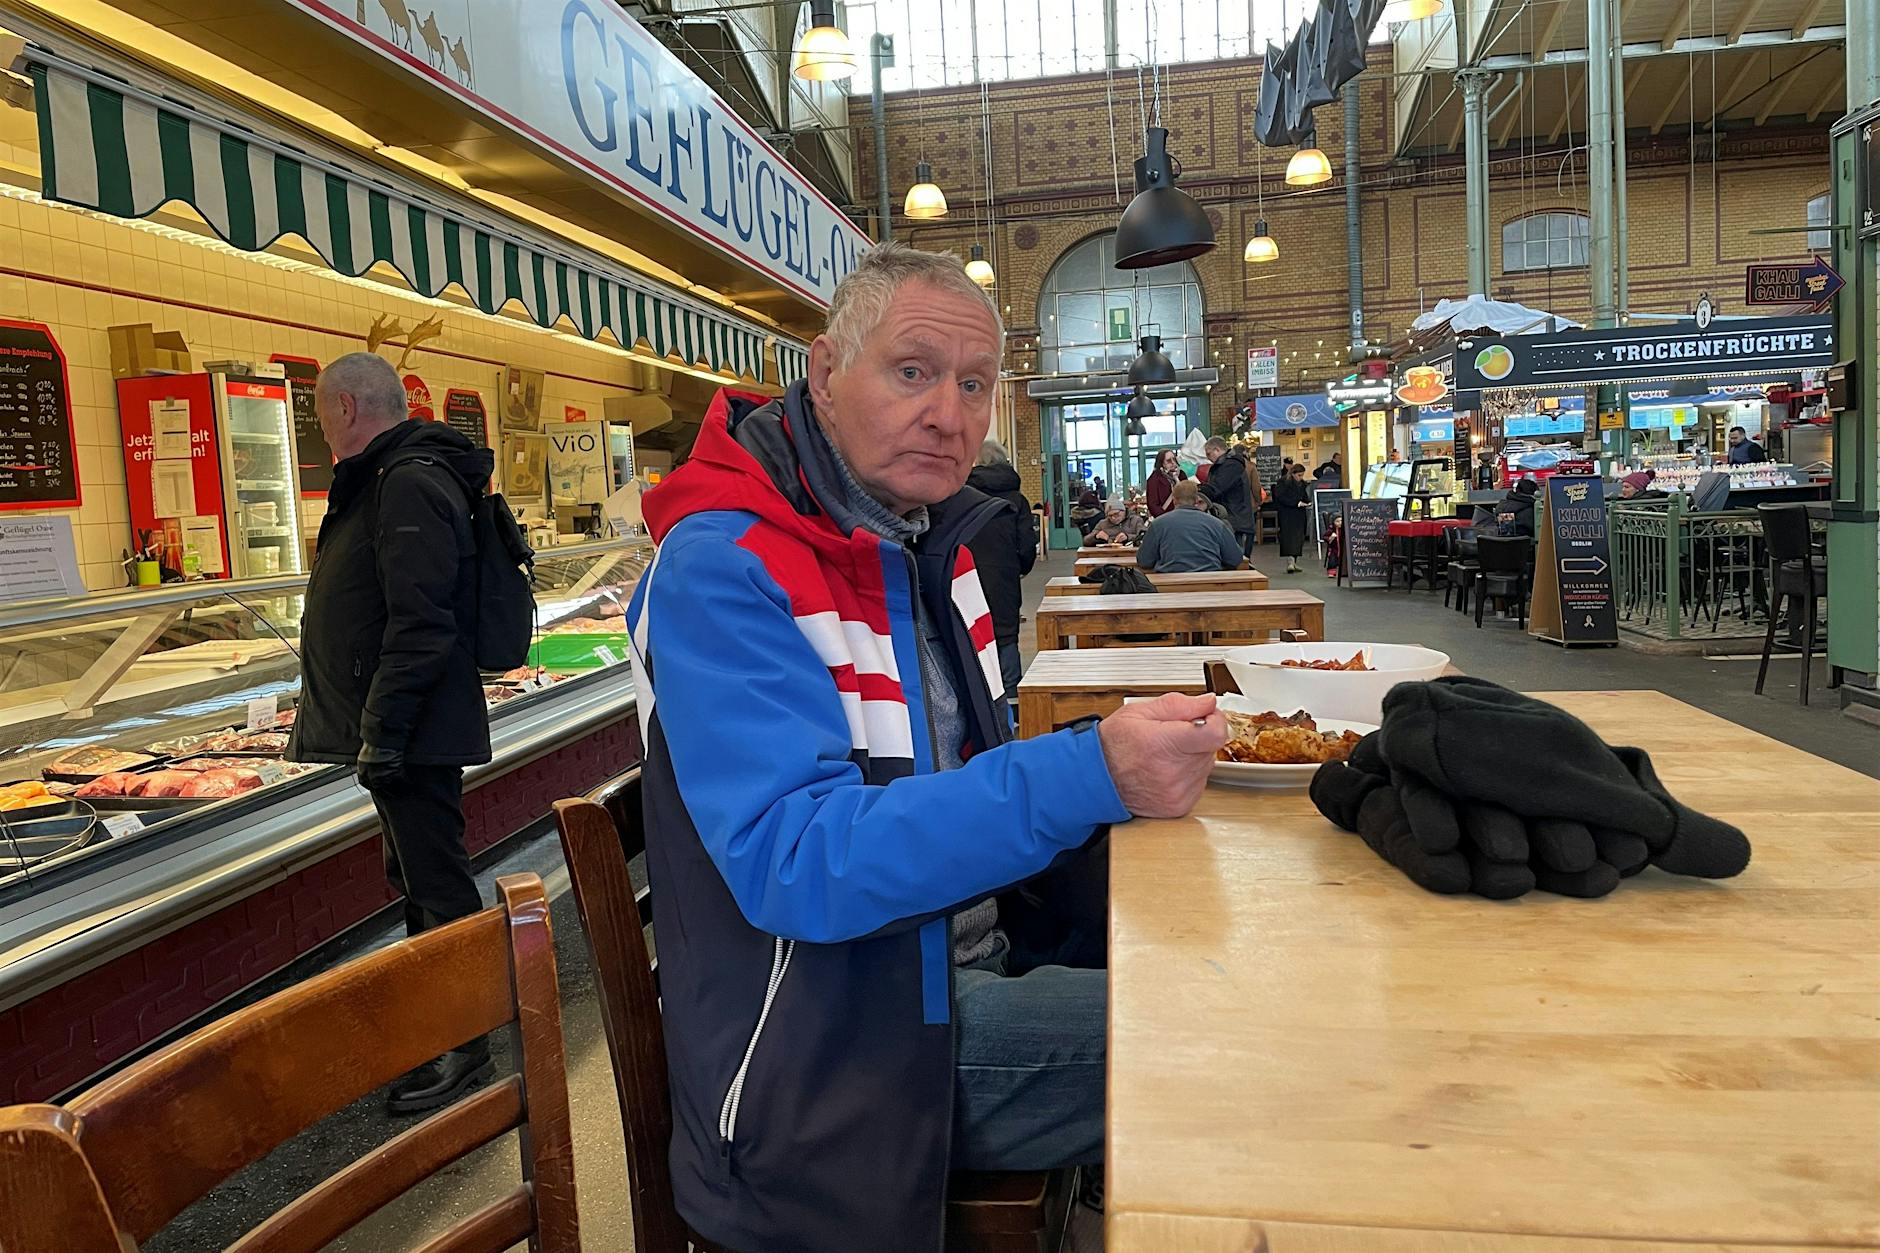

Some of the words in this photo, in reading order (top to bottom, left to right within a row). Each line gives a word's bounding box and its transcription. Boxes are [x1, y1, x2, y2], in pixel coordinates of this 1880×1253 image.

[1756, 269, 1800, 285] KHAU
[1755, 285, 1800, 300] GALLI
[1701, 311, 1706, 326] 3
[1612, 333, 1814, 362] TROCKENFRÜCHTE
[1252, 368, 1275, 376] IMBISS
[552, 434, 595, 453] ViO
[1350, 505, 1373, 515] Kaffee
[1558, 507, 1601, 522] KHAU
[1558, 524, 1604, 539] GALLI
